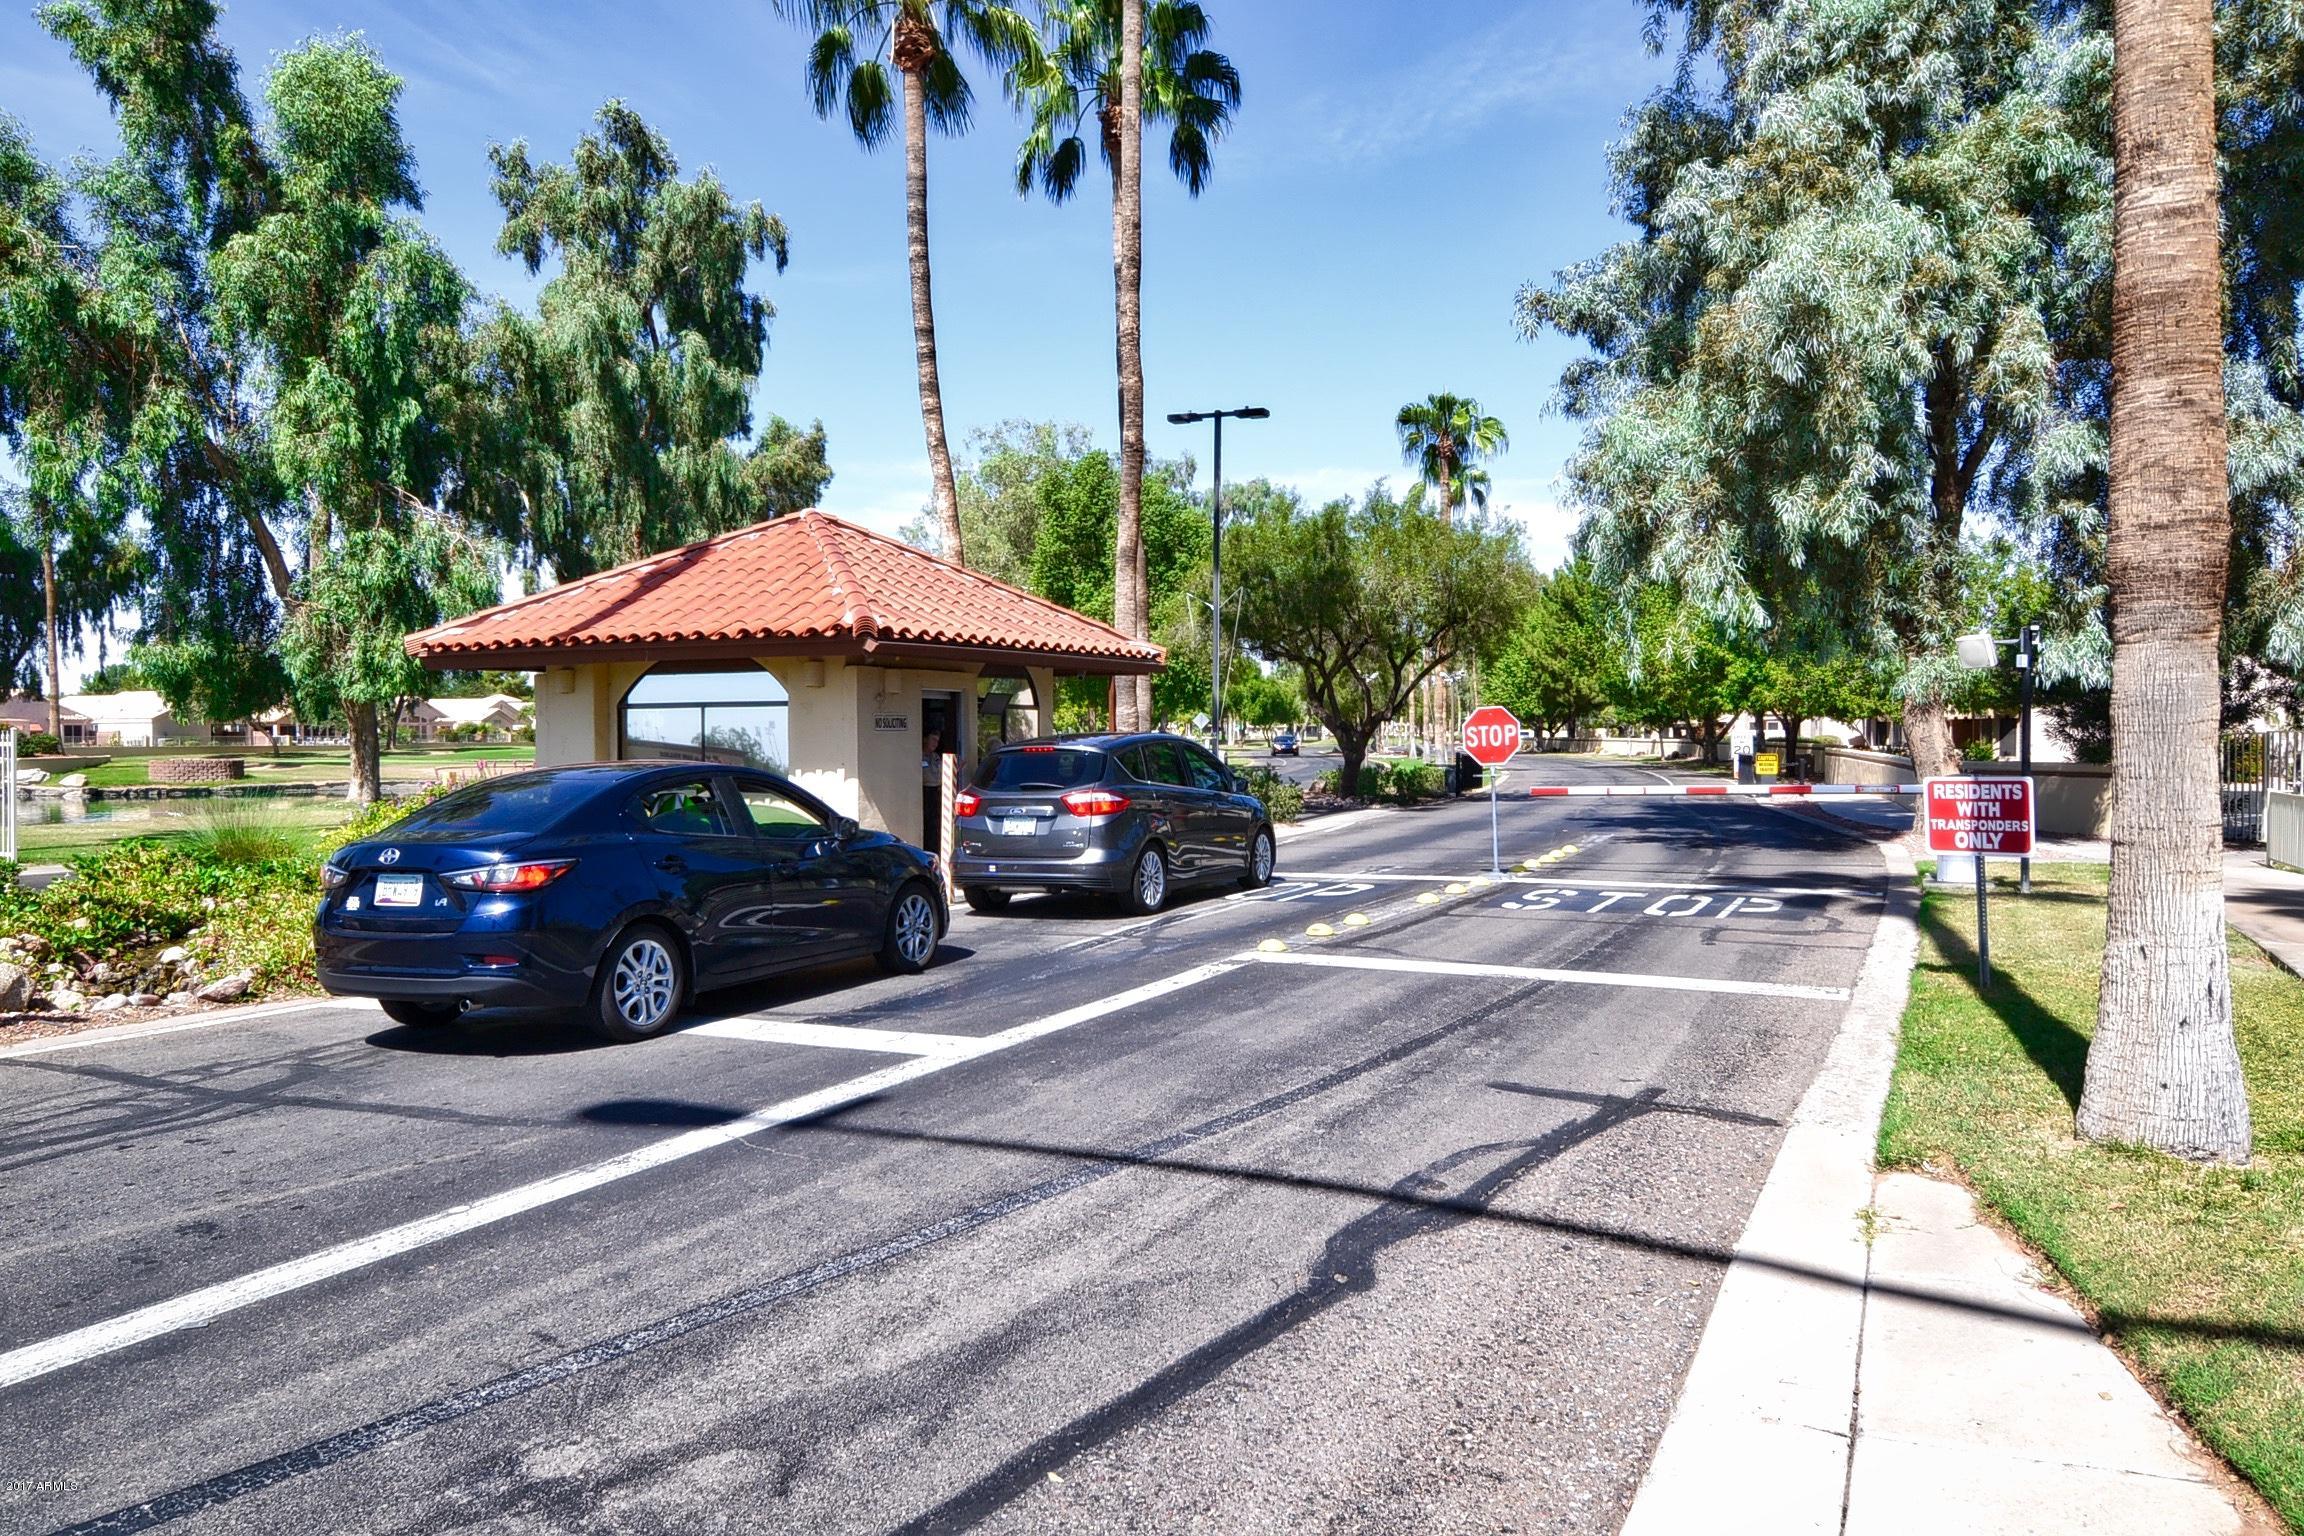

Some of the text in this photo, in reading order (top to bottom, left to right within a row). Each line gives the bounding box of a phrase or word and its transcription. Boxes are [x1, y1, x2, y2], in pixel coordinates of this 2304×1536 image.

[1466, 724, 1516, 748] STOP
[1733, 745, 1751, 755] 20
[1933, 783, 2023, 800] RESIDENTS
[1956, 801, 2001, 817] WITH
[1930, 818, 2029, 832] TRANSPONDERS
[1954, 831, 2004, 849] ONLY
[1224, 882, 1375, 902] OP
[1501, 888, 1784, 919] STOP
